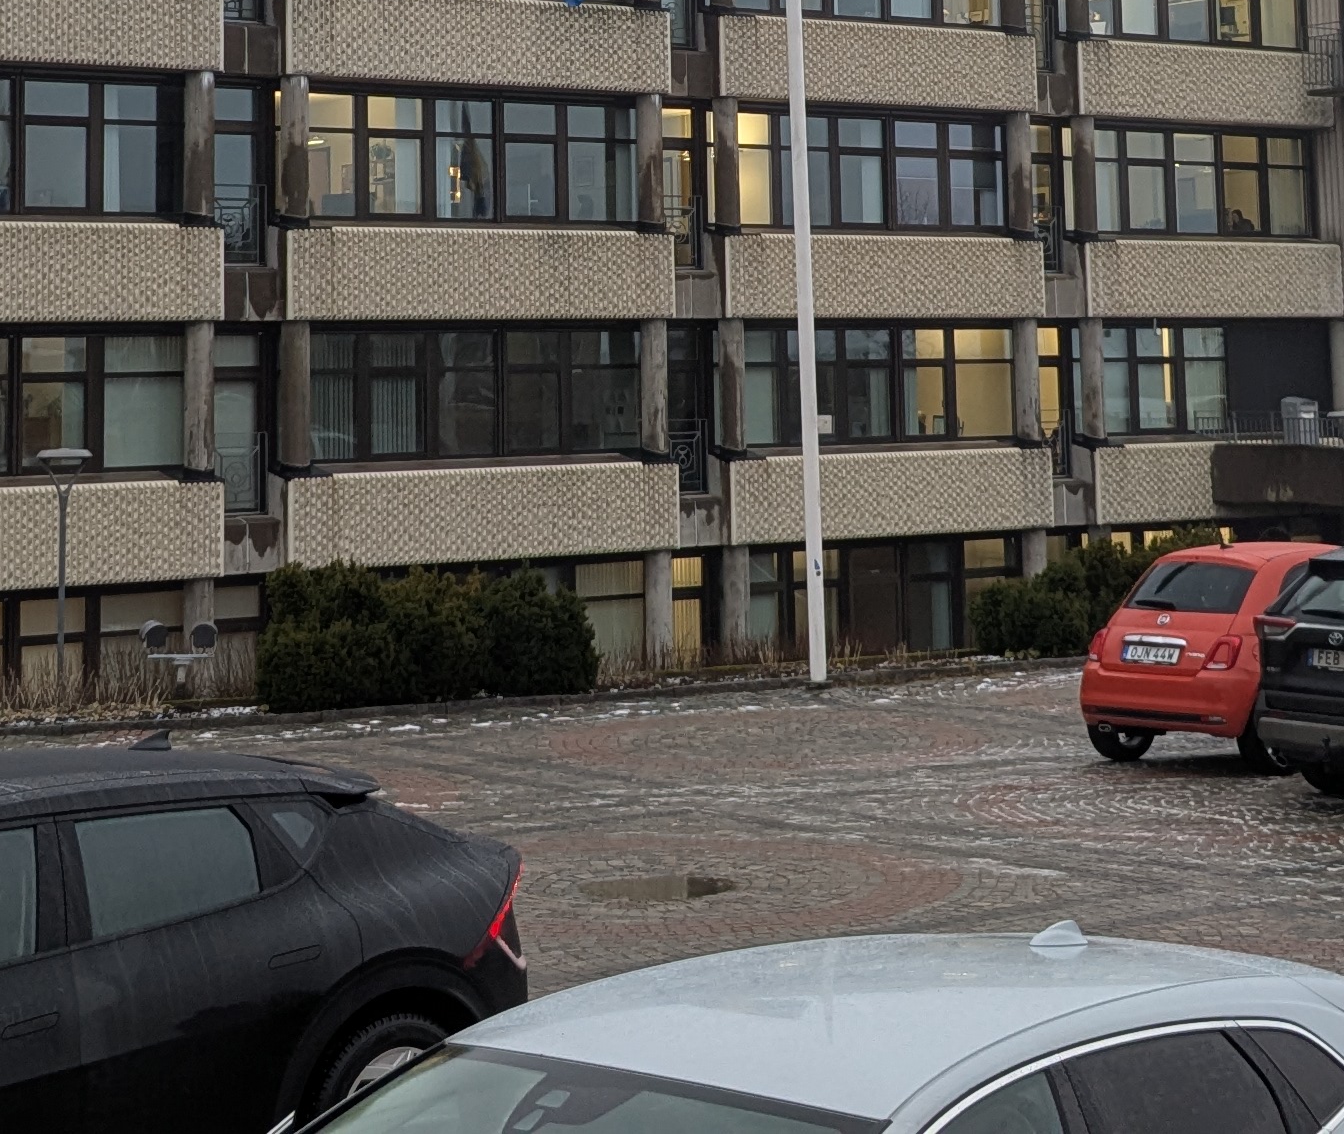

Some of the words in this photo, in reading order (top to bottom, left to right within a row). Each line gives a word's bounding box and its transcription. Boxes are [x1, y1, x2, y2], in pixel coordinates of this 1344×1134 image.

[1130, 646, 1152, 659] OJN
[1152, 647, 1176, 661] 44W
[1317, 650, 1340, 666] FEB
